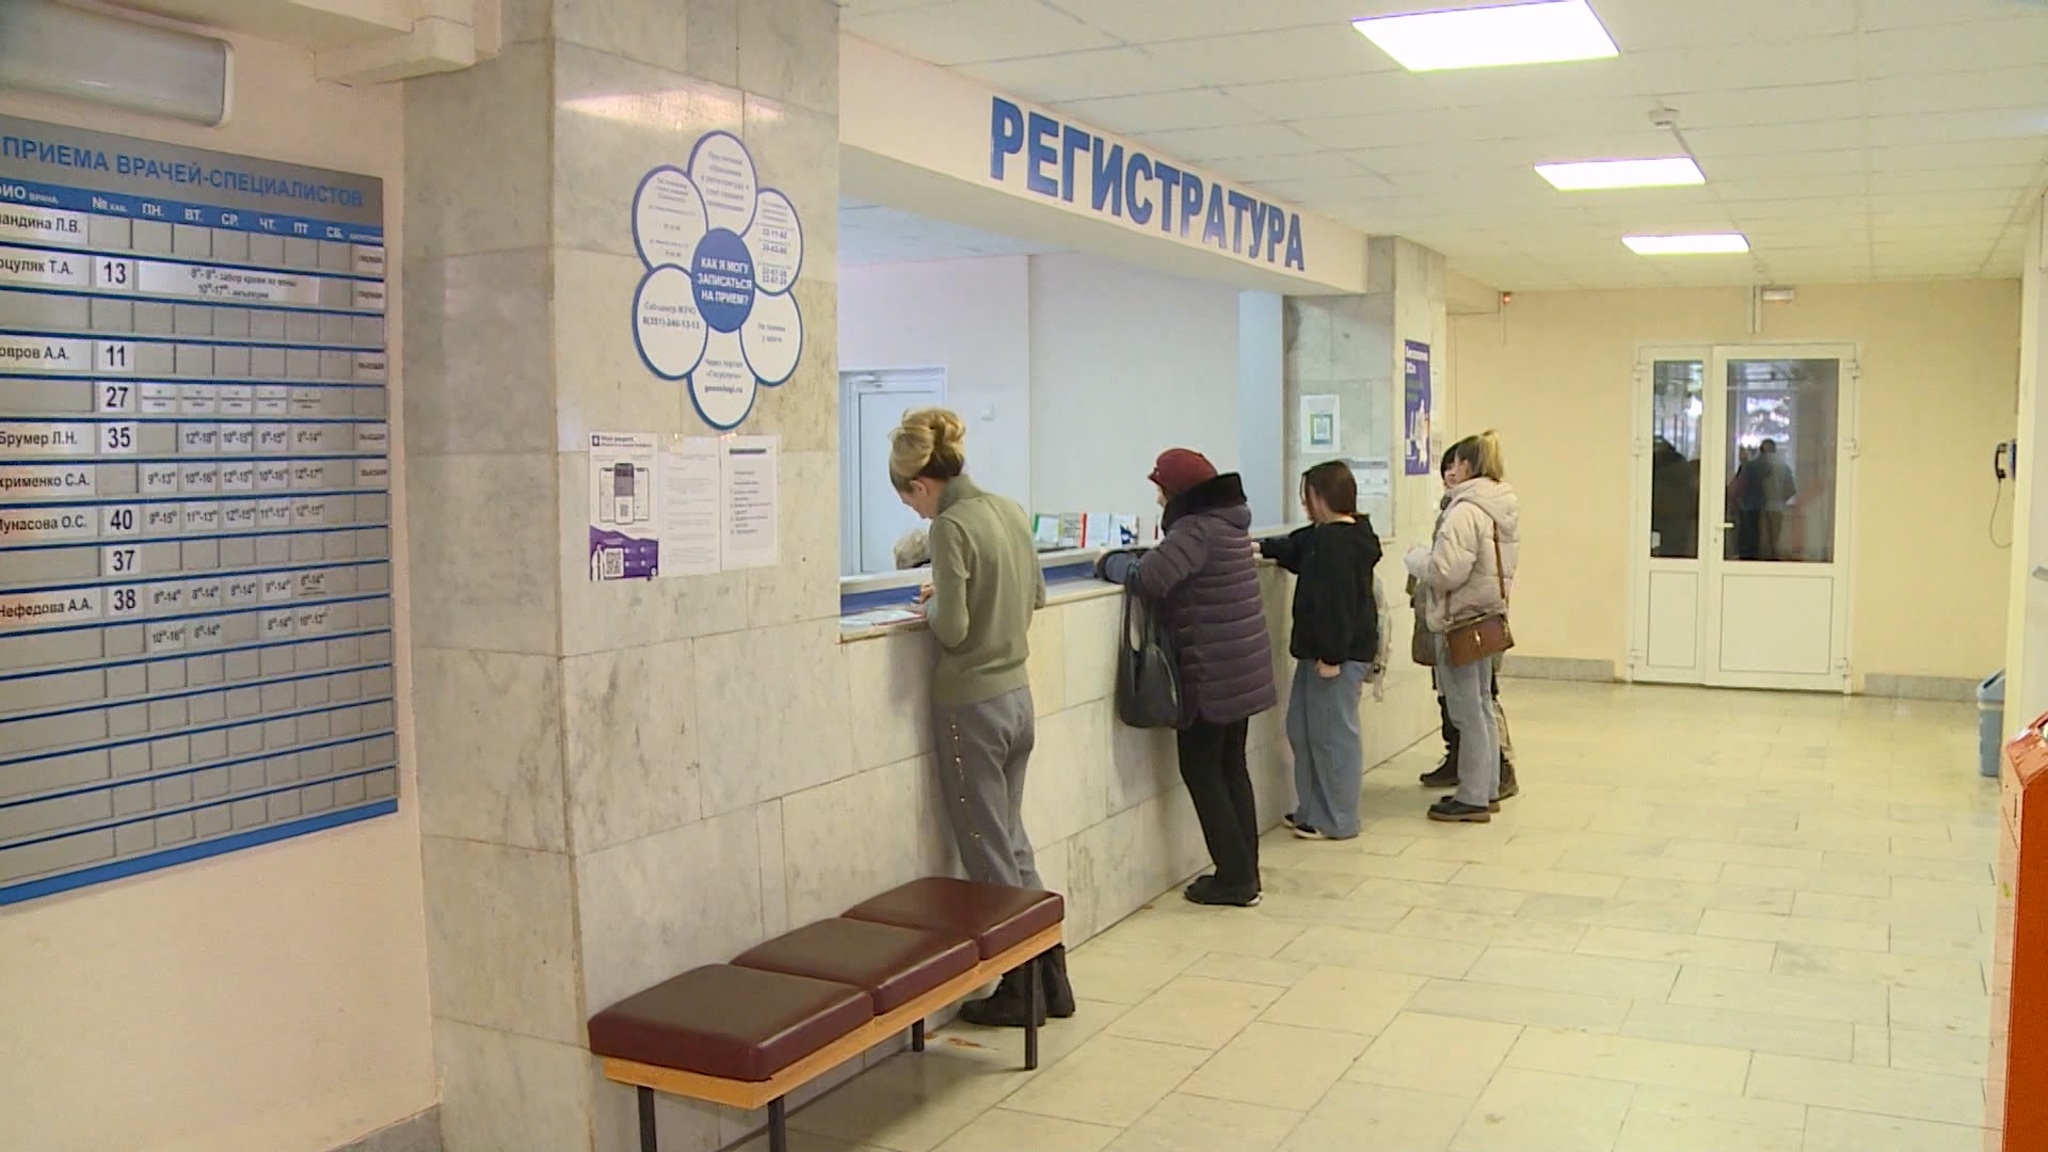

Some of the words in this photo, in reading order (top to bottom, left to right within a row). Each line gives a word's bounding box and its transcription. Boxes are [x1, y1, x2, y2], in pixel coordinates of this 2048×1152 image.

[2, 136, 109, 171] ПРИЕМА
[117, 154, 362, 207] ВРАЧЕЙ-СПЕЦИАЛИСТОВ
[990, 96, 1304, 271] РЕГИСТРАТУРА
[0, 213, 51, 230] андина
[56, 217, 82, 233] Л.В.
[104, 261, 126, 284] 13
[701, 256, 718, 269] КАК
[719, 259, 727, 271] Я
[727, 260, 749, 274] МОГУ
[697, 272, 752, 291] ЗАПИСАТЬСЯ
[701, 288, 714, 302] НА
[44, 345, 70, 360] А.А.
[106, 344, 126, 367] 11
[105, 385, 128, 408] 27
[52, 430, 78, 445] Л.Н.
[108, 426, 131, 449] 35
[65, 473, 90, 486] С.А.
[61, 514, 87, 529] О.С.
[110, 508, 133, 530] 40
[112, 549, 135, 572] 37
[68, 597, 92, 612] А.А.
[113, 588, 136, 611] 38
